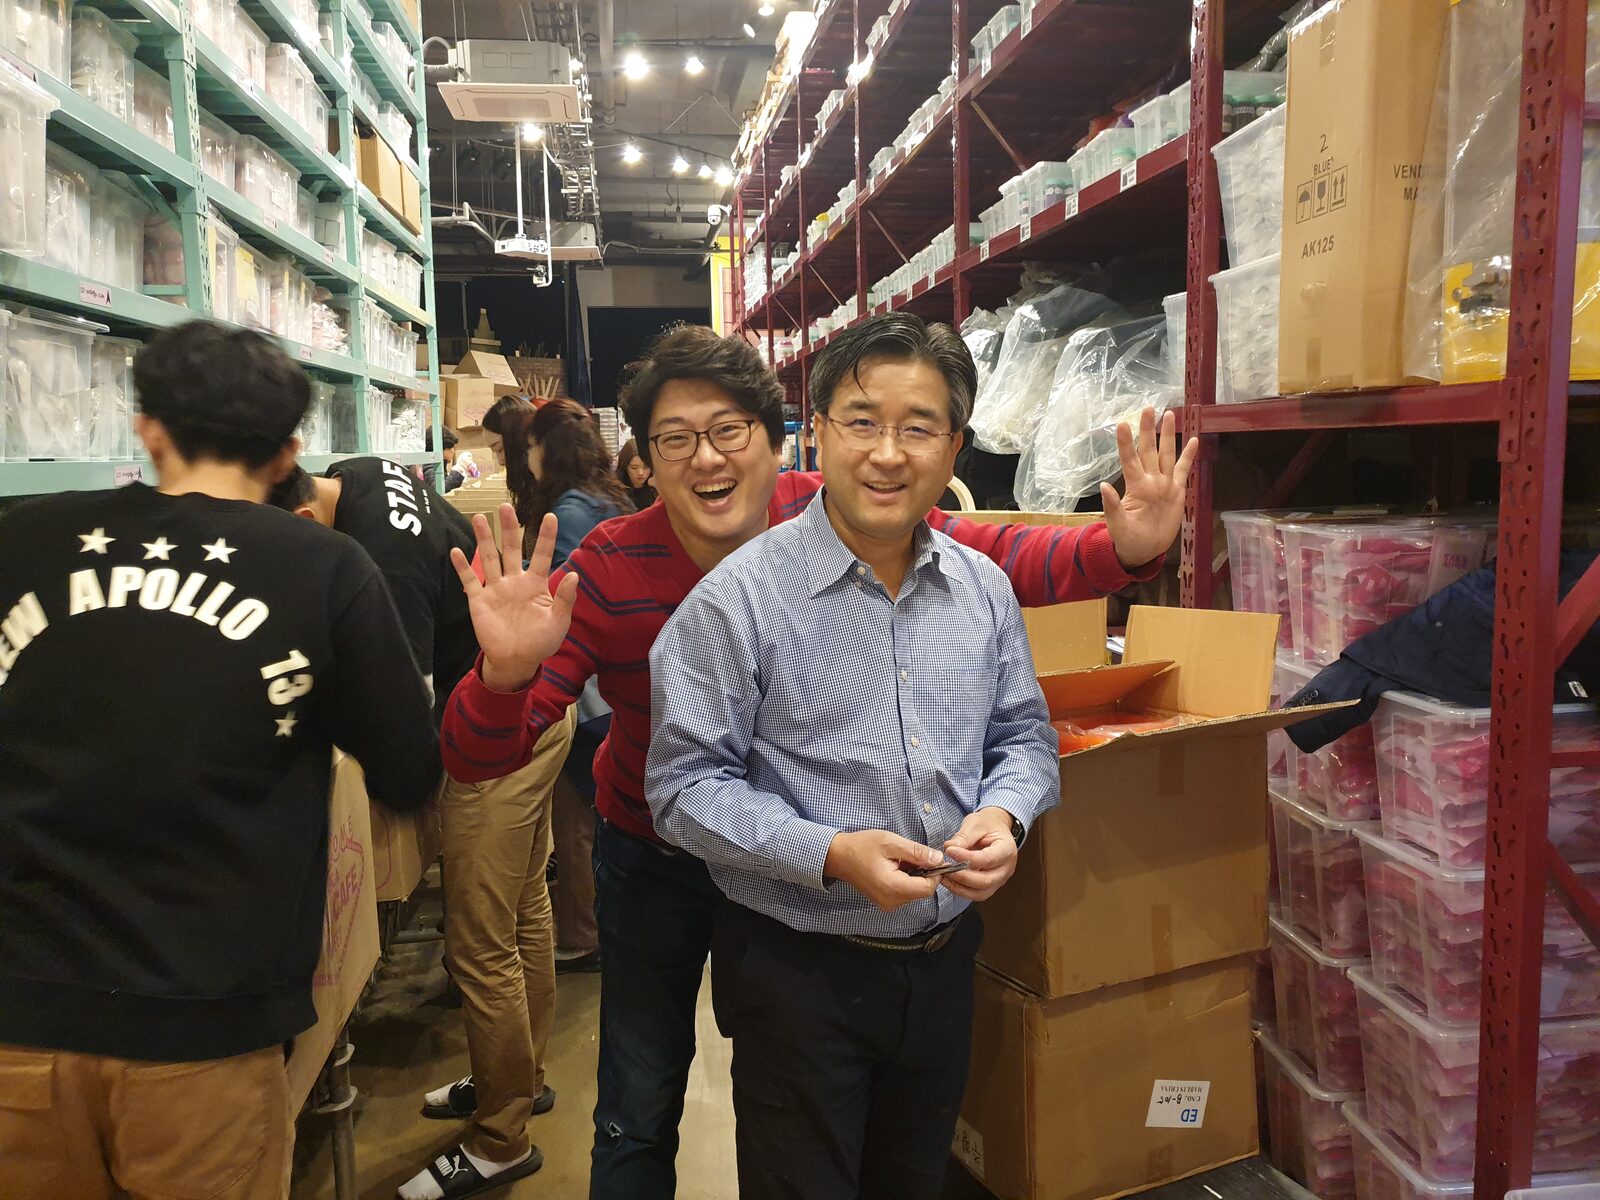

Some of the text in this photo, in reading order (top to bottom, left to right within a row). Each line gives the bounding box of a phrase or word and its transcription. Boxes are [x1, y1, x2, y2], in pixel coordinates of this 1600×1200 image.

[1319, 133, 1329, 153] 2
[1301, 235, 1335, 259] AK125
[382, 460, 422, 537] STAF
[0, 566, 314, 706] EW APOLLO 13
[1181, 1108, 1198, 1122] ED
